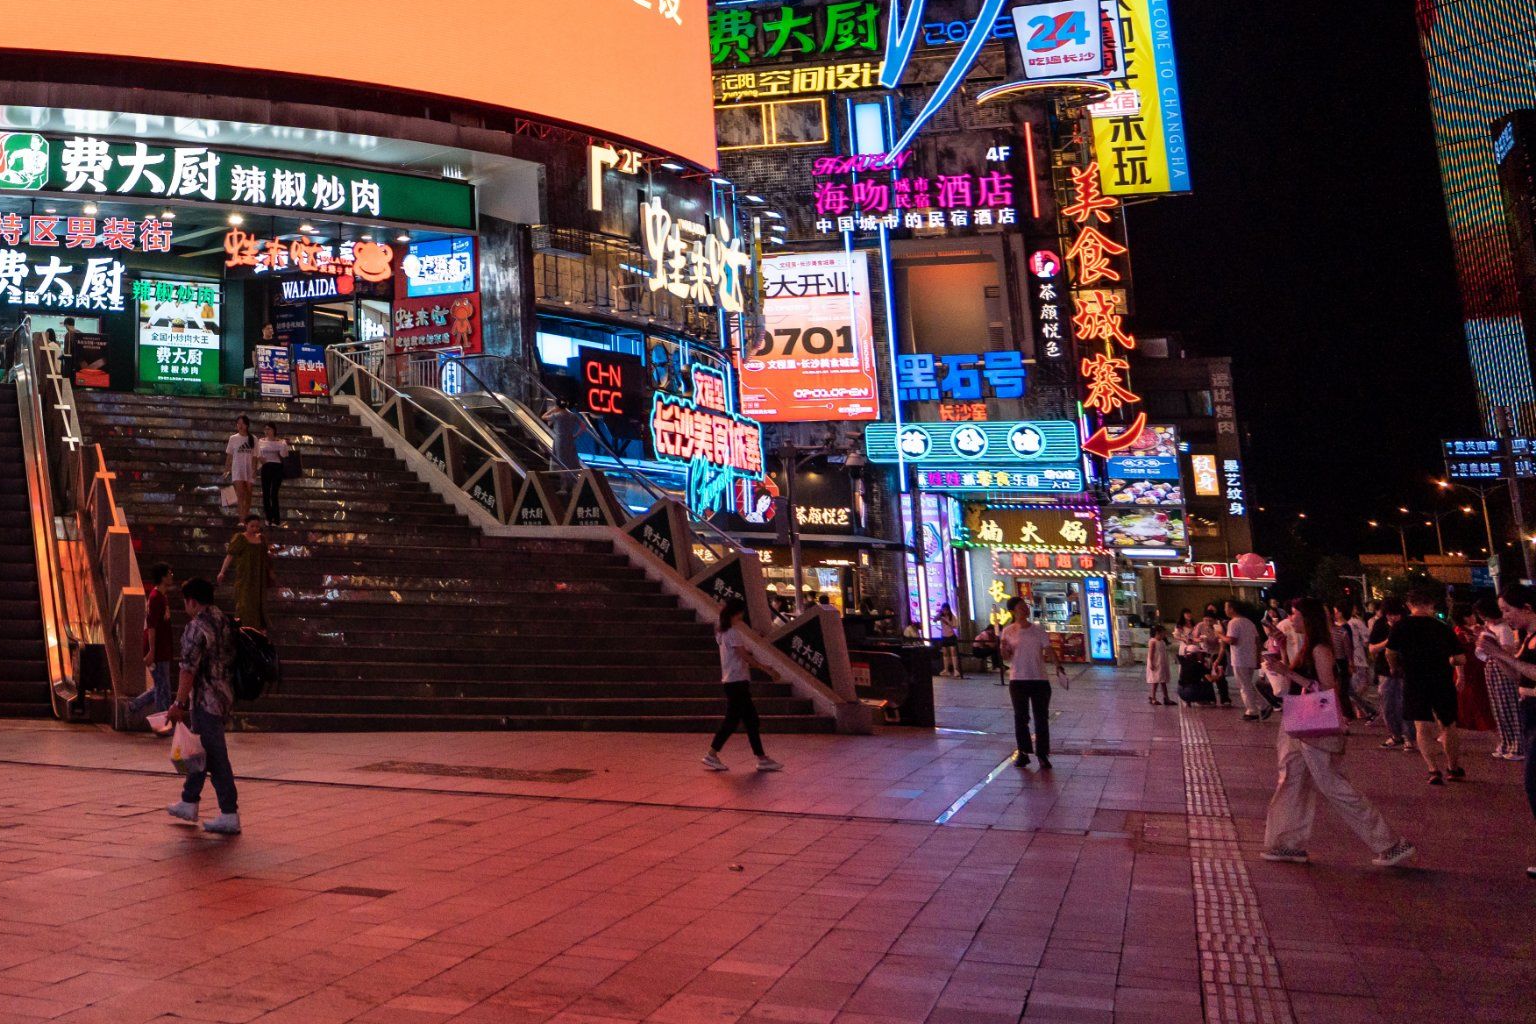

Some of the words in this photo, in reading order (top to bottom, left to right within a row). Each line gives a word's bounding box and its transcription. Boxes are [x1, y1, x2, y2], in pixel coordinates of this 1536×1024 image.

[709, 0, 881, 64] 费大厨
[1027, 10, 1091, 52] 24
[1158, 59, 1175, 79] TO
[1163, 86, 1187, 179] CHANGSHA
[618, 148, 643, 175] 2F
[985, 146, 1011, 163] 4F
[62, 137, 221, 202] 费大厨
[230, 164, 381, 216] 辣椒炒肉
[814, 178, 888, 215] 海吻
[936, 171, 1015, 208] 酒店
[815, 207, 1017, 233] 中国城市的民宿酒店
[131, 280, 216, 308] 辣椒炒肉
[282, 277, 338, 300] WALAIDA
[1063, 161, 1141, 415] 美食城寨
[151, 332, 209, 345] 全国小炒肉大王
[156, 346, 203, 366] 费大厨
[297, 359, 325, 373] 营业中
[160, 365, 199, 375] 辣椒炒肉
[896, 350, 1027, 400] 黑石号
[652, 401, 764, 474] 长沙美食城寨
[1223, 460, 1245, 516] 墨艺纹身
[977, 520, 1088, 544] 楠火锅
[1010, 553, 1096, 570] 楠楠超市
[1088, 593, 1107, 627] 超市
